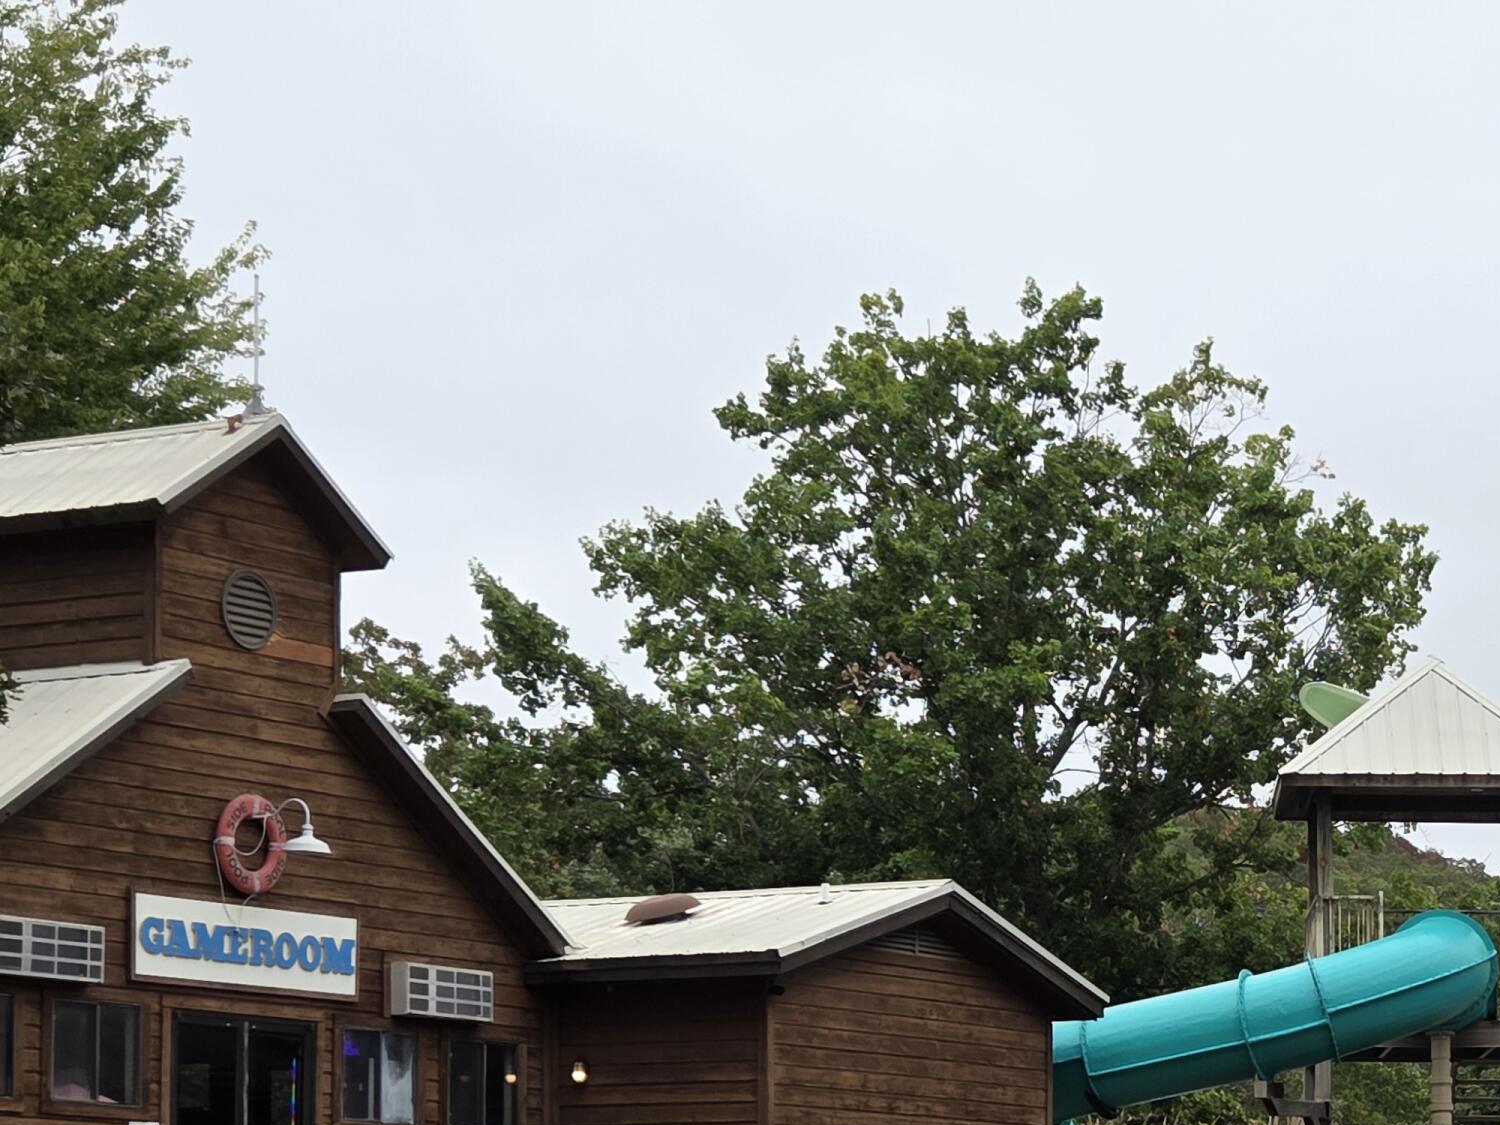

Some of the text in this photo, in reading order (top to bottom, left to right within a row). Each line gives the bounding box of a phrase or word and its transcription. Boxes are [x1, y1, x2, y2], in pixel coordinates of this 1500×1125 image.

[226, 801, 249, 885] POOL SIDE
[139, 916, 356, 976] GAMEROOM
